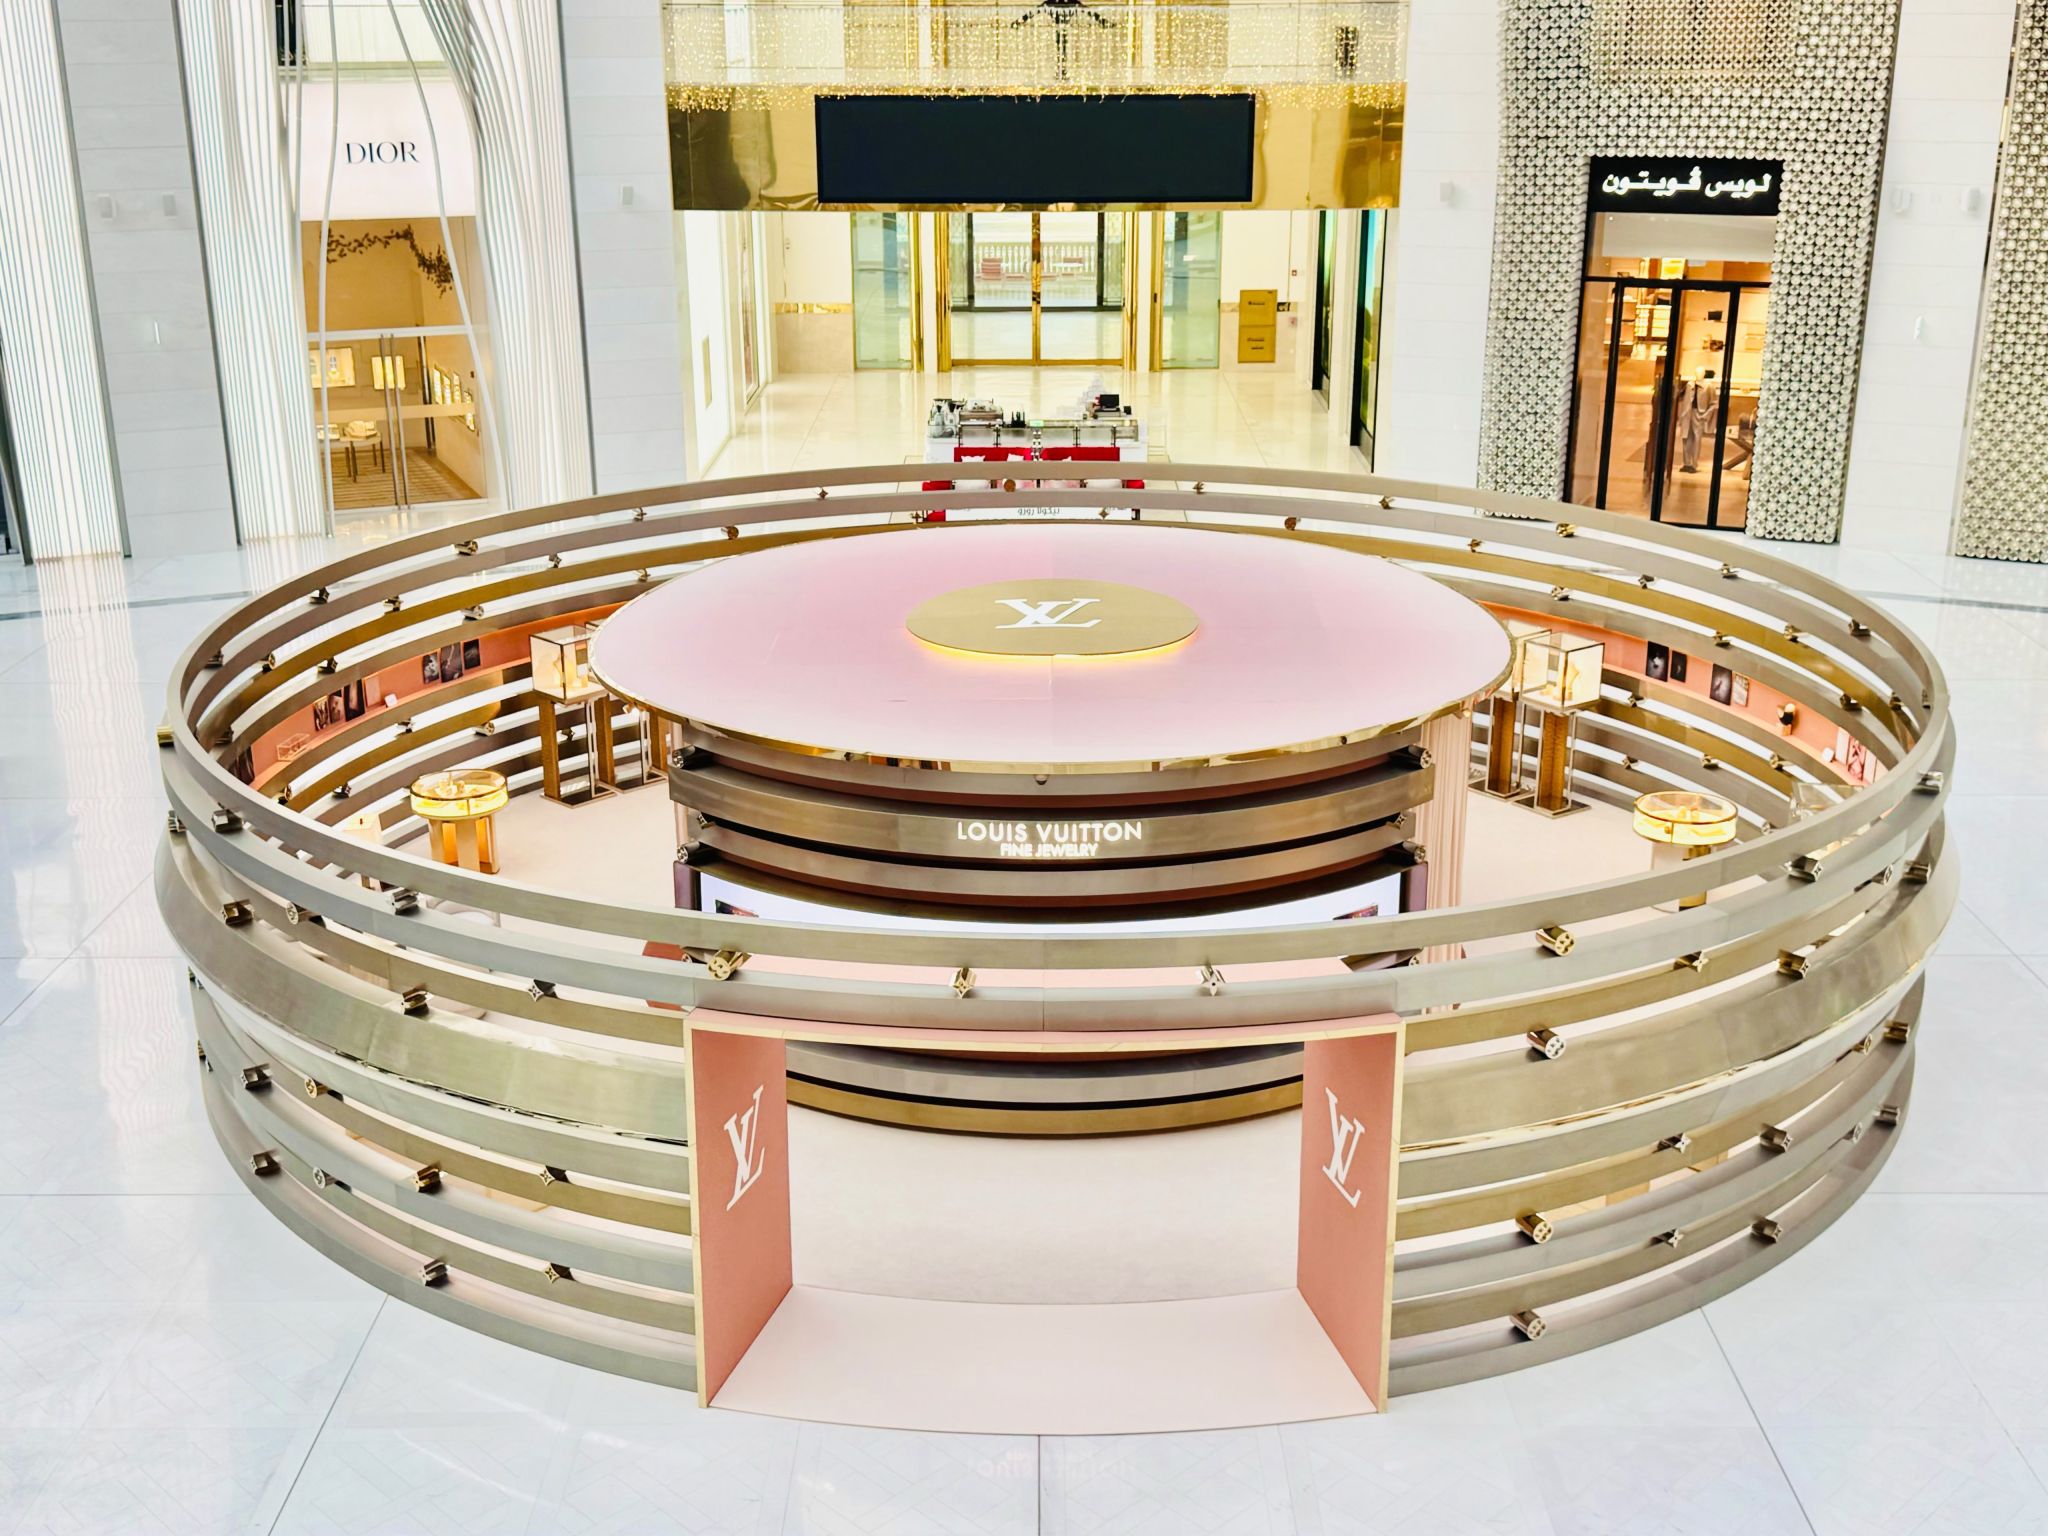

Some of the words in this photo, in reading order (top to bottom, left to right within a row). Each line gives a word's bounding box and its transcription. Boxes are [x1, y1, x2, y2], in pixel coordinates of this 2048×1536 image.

[345, 141, 420, 164] DIOR
[1704, 173, 1772, 198] لويس
[957, 821, 1028, 842] LOUIS
[1036, 821, 1142, 842] VUITTON
[1000, 843, 1033, 857] FINE
[1035, 843, 1099, 858] JEWELRY
